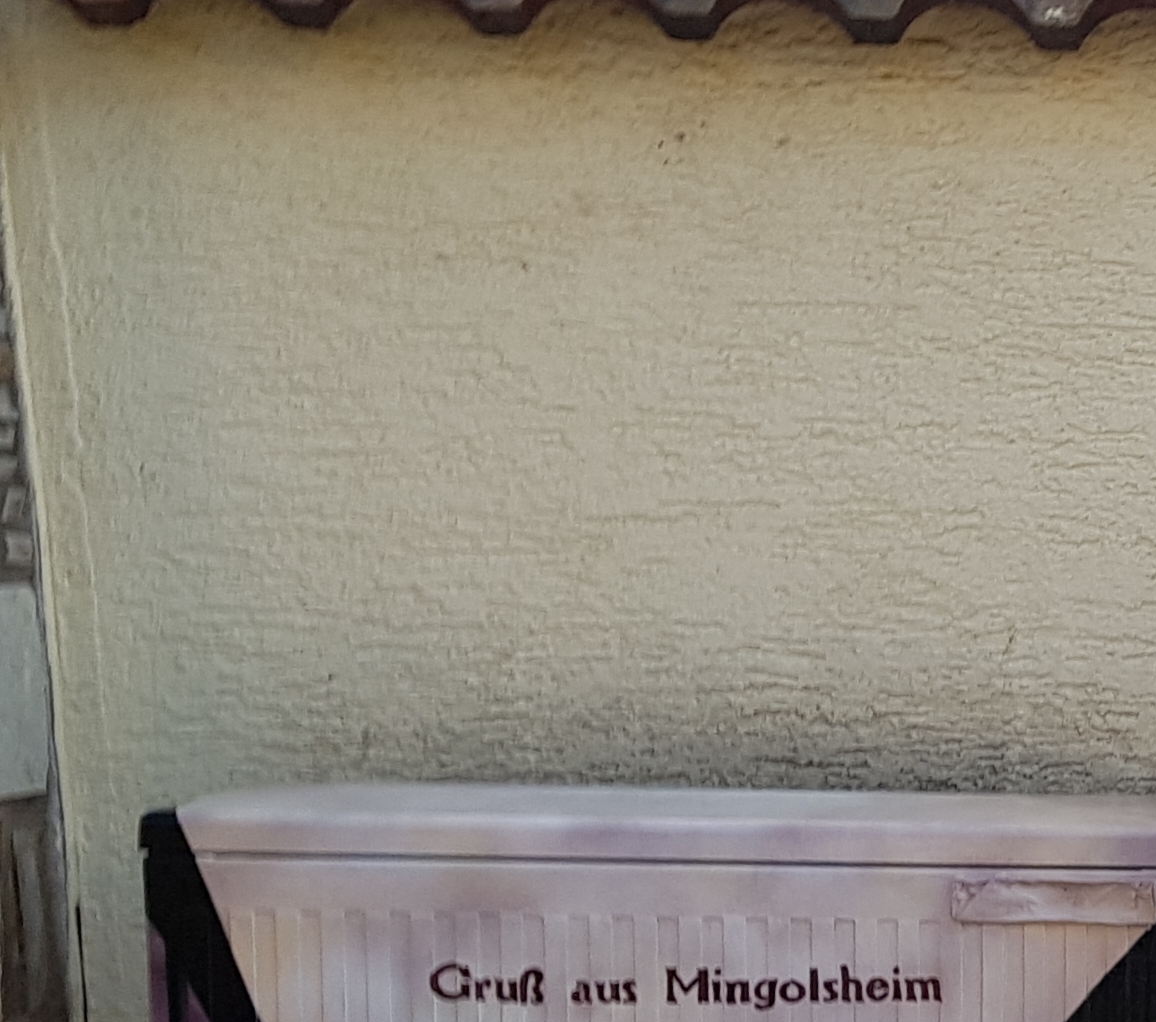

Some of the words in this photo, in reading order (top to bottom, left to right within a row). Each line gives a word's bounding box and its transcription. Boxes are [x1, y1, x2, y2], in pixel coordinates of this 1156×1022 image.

[429, 961, 544, 1005] Gruß
[571, 975, 638, 1004] aus
[665, 964, 944, 1011] Mingolsheim
